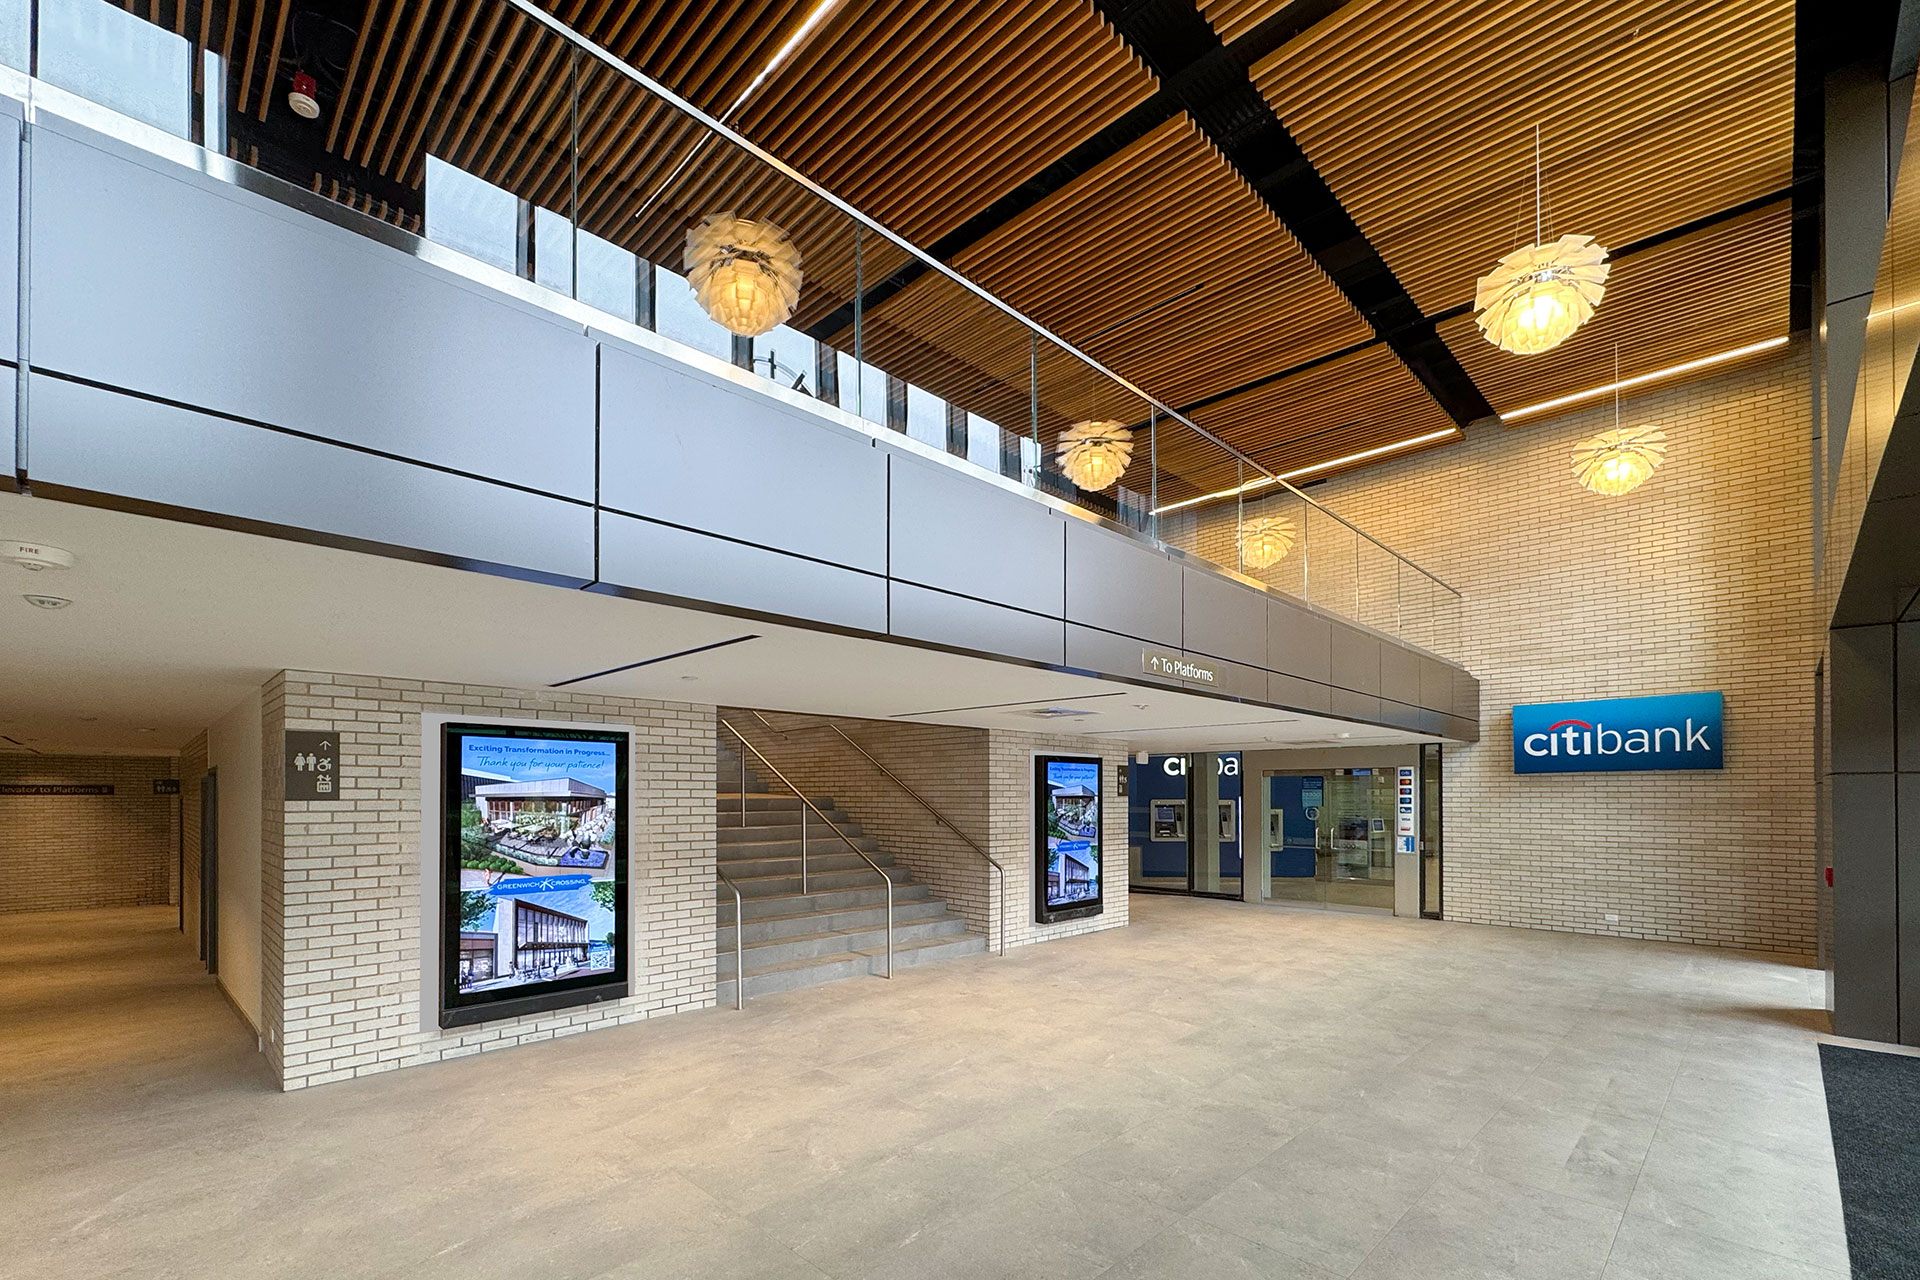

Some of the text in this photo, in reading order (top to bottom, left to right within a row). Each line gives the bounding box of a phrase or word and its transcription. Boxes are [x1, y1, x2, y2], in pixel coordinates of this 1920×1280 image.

[20, 546, 40, 555] FIRE
[1161, 657, 1214, 682] To Platforms
[1523, 717, 1712, 757] citibank
[468, 744, 503, 754] Exciting
[504, 745, 564, 755] Transformation
[477, 755, 605, 773] Thank you for your patience!
[53, 786, 99, 794] Platforms
[496, 881, 540, 890] GREENWICH
[550, 878, 586, 887] CROSSING
